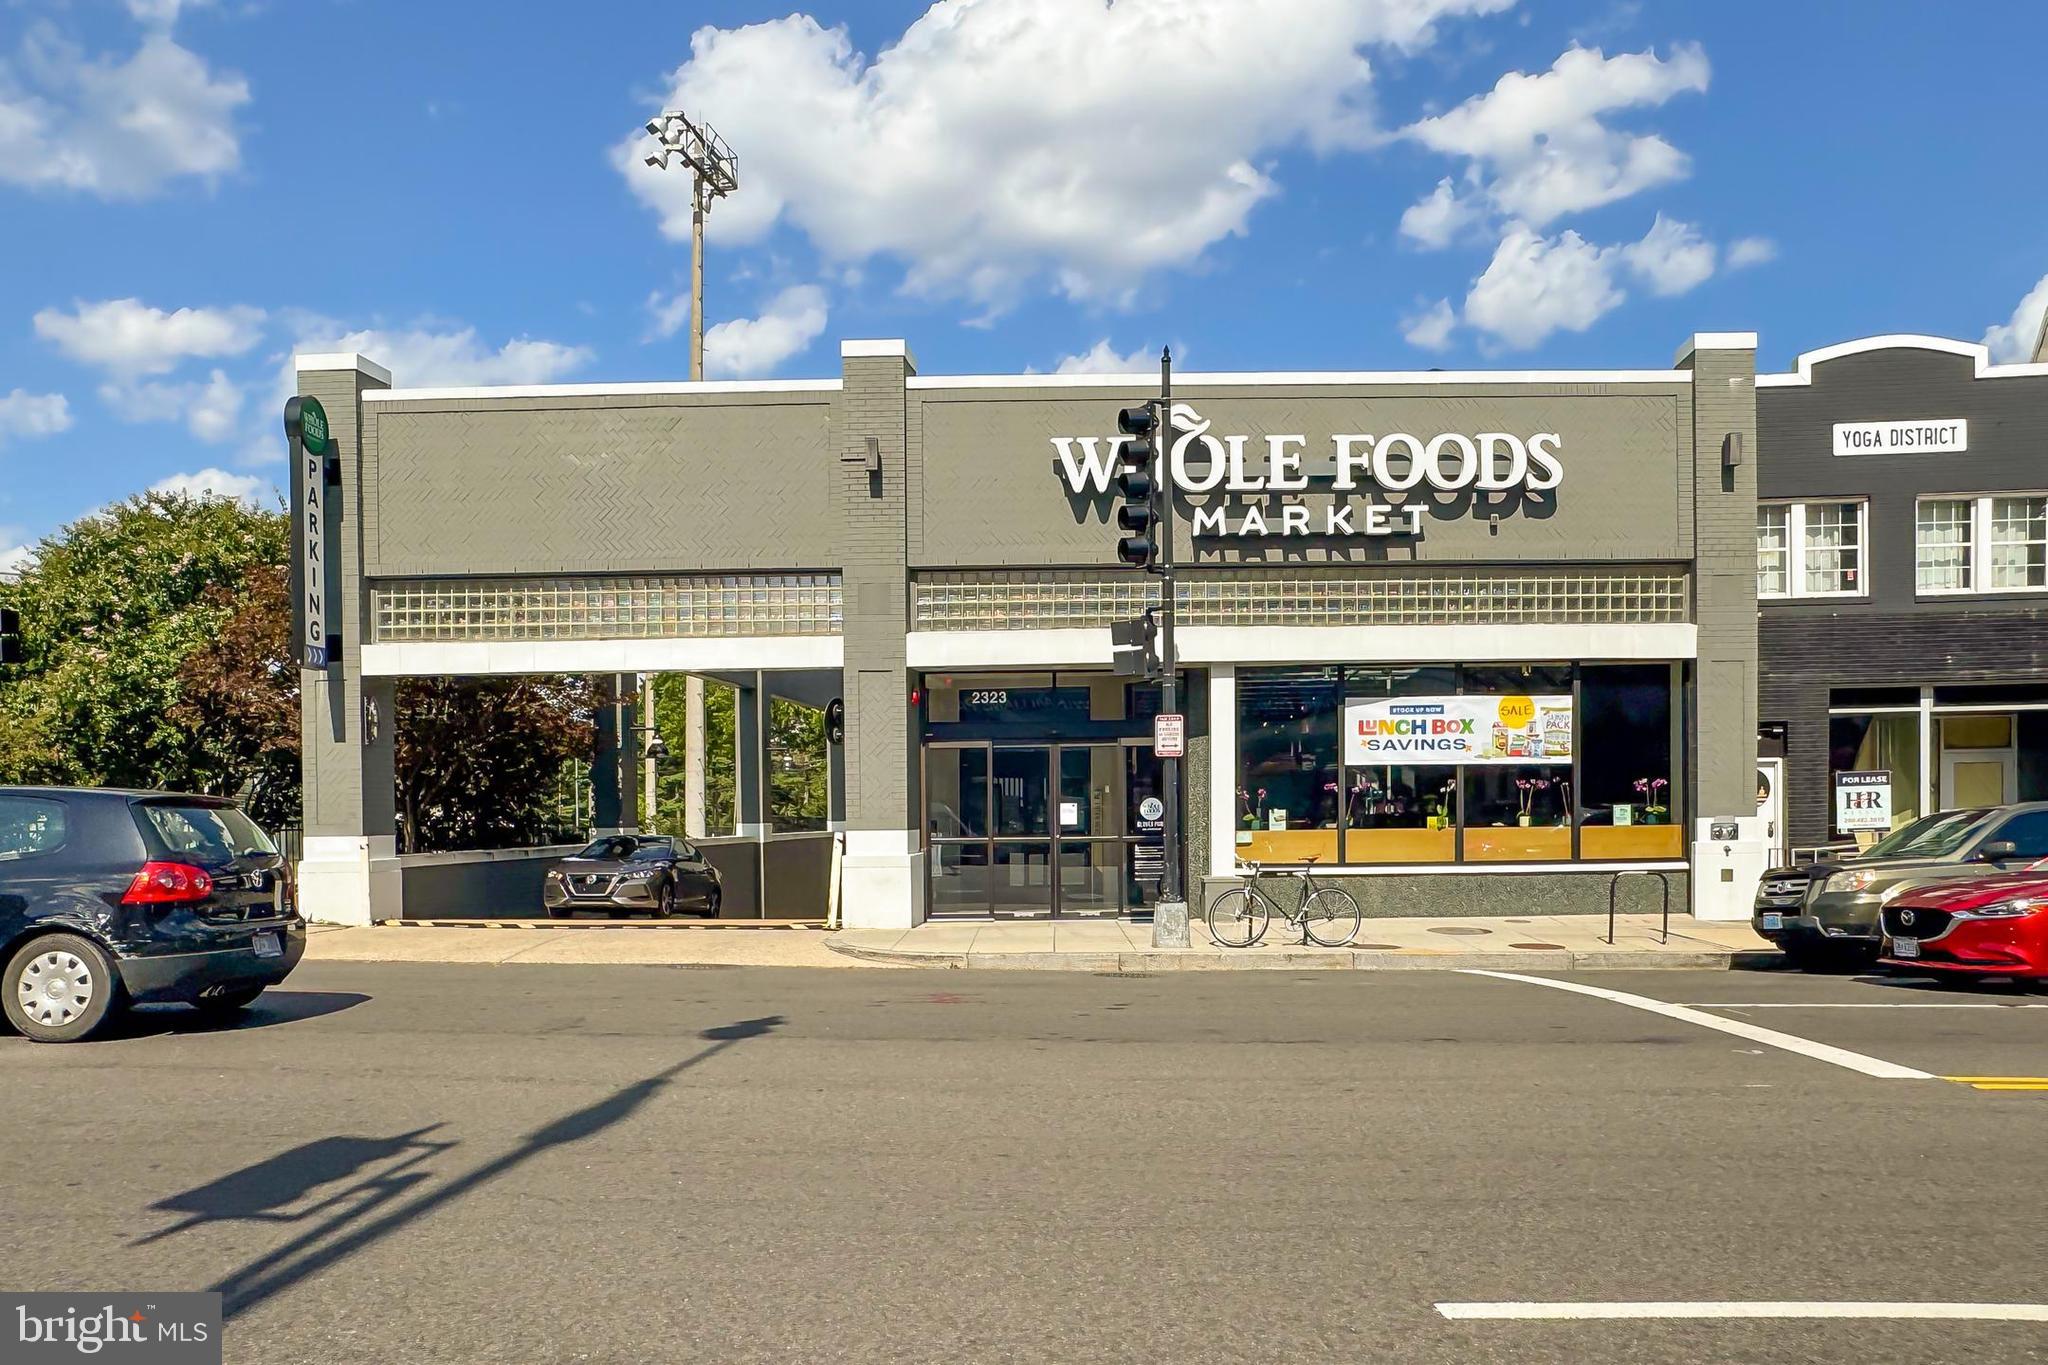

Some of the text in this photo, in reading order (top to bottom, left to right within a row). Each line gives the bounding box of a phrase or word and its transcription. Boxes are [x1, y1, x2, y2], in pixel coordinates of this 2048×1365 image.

[1843, 426, 1958, 448] YOGA DISTRICT
[1331, 430, 1565, 493] FOODS
[1192, 502, 1430, 537] MARKET
[307, 459, 321, 642] PARKING
[971, 691, 1007, 704] 2323
[1500, 704, 1533, 717] SALE
[1358, 719, 1475, 736] LUNCH BOX
[1545, 720, 1570, 729] PACK
[1367, 738, 1466, 751] SAVINGS
